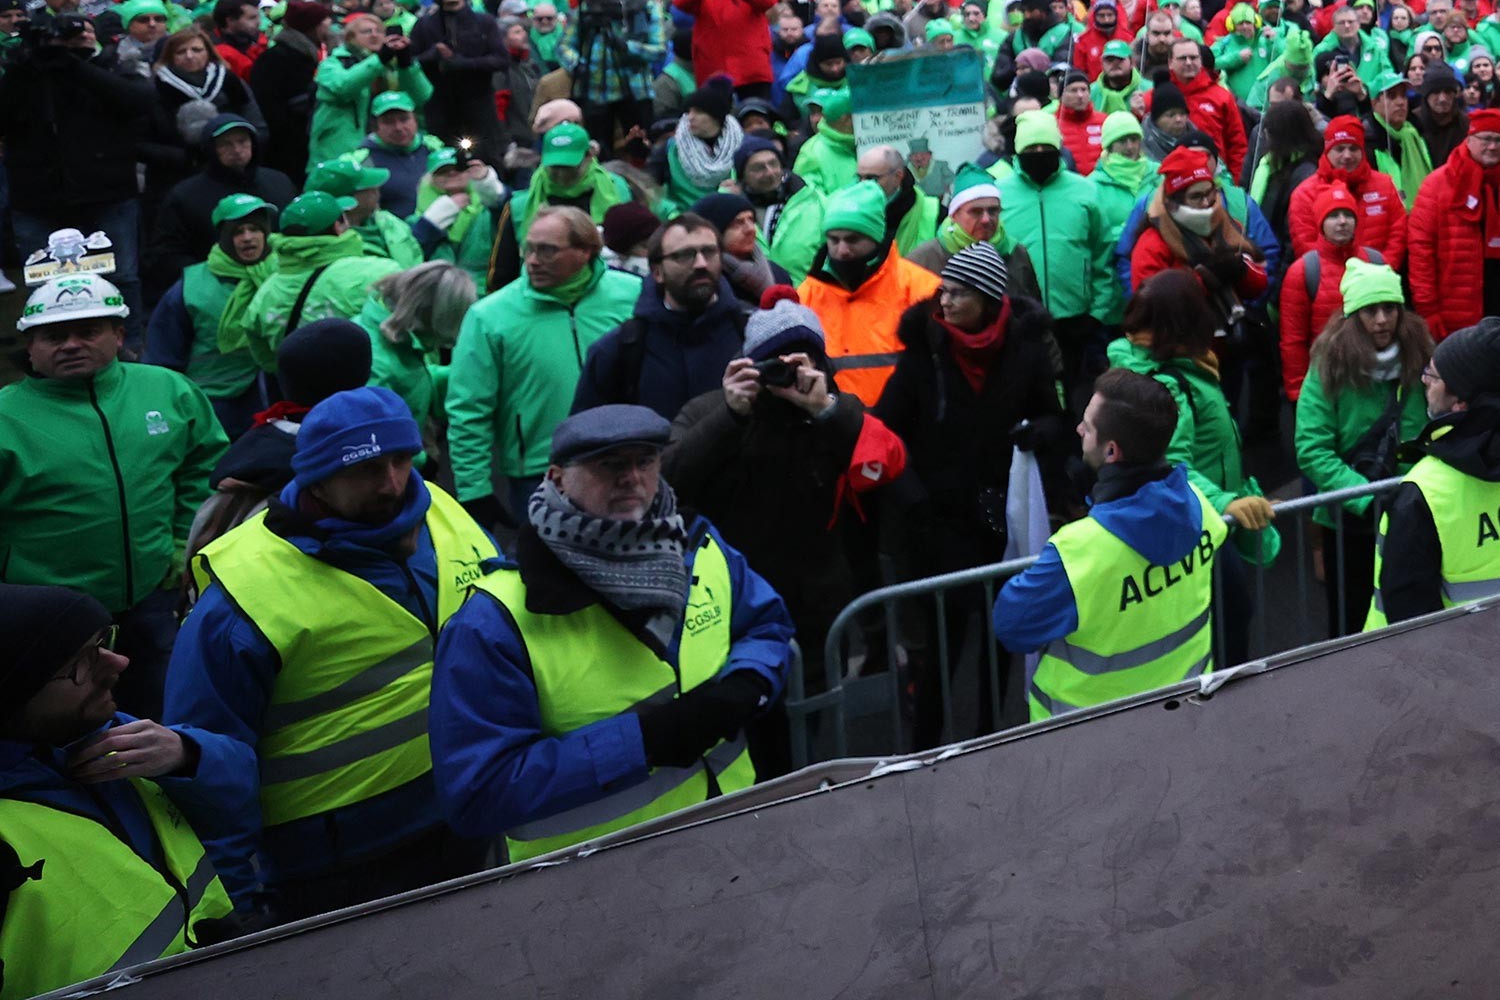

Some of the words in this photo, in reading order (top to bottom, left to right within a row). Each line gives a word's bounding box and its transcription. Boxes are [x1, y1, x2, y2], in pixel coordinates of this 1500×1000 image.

[342, 445, 381, 462] CGSLB
[455, 568, 481, 587] ACLV
[1118, 529, 1214, 613] ACLVB
[685, 605, 721, 631] CGSLB
